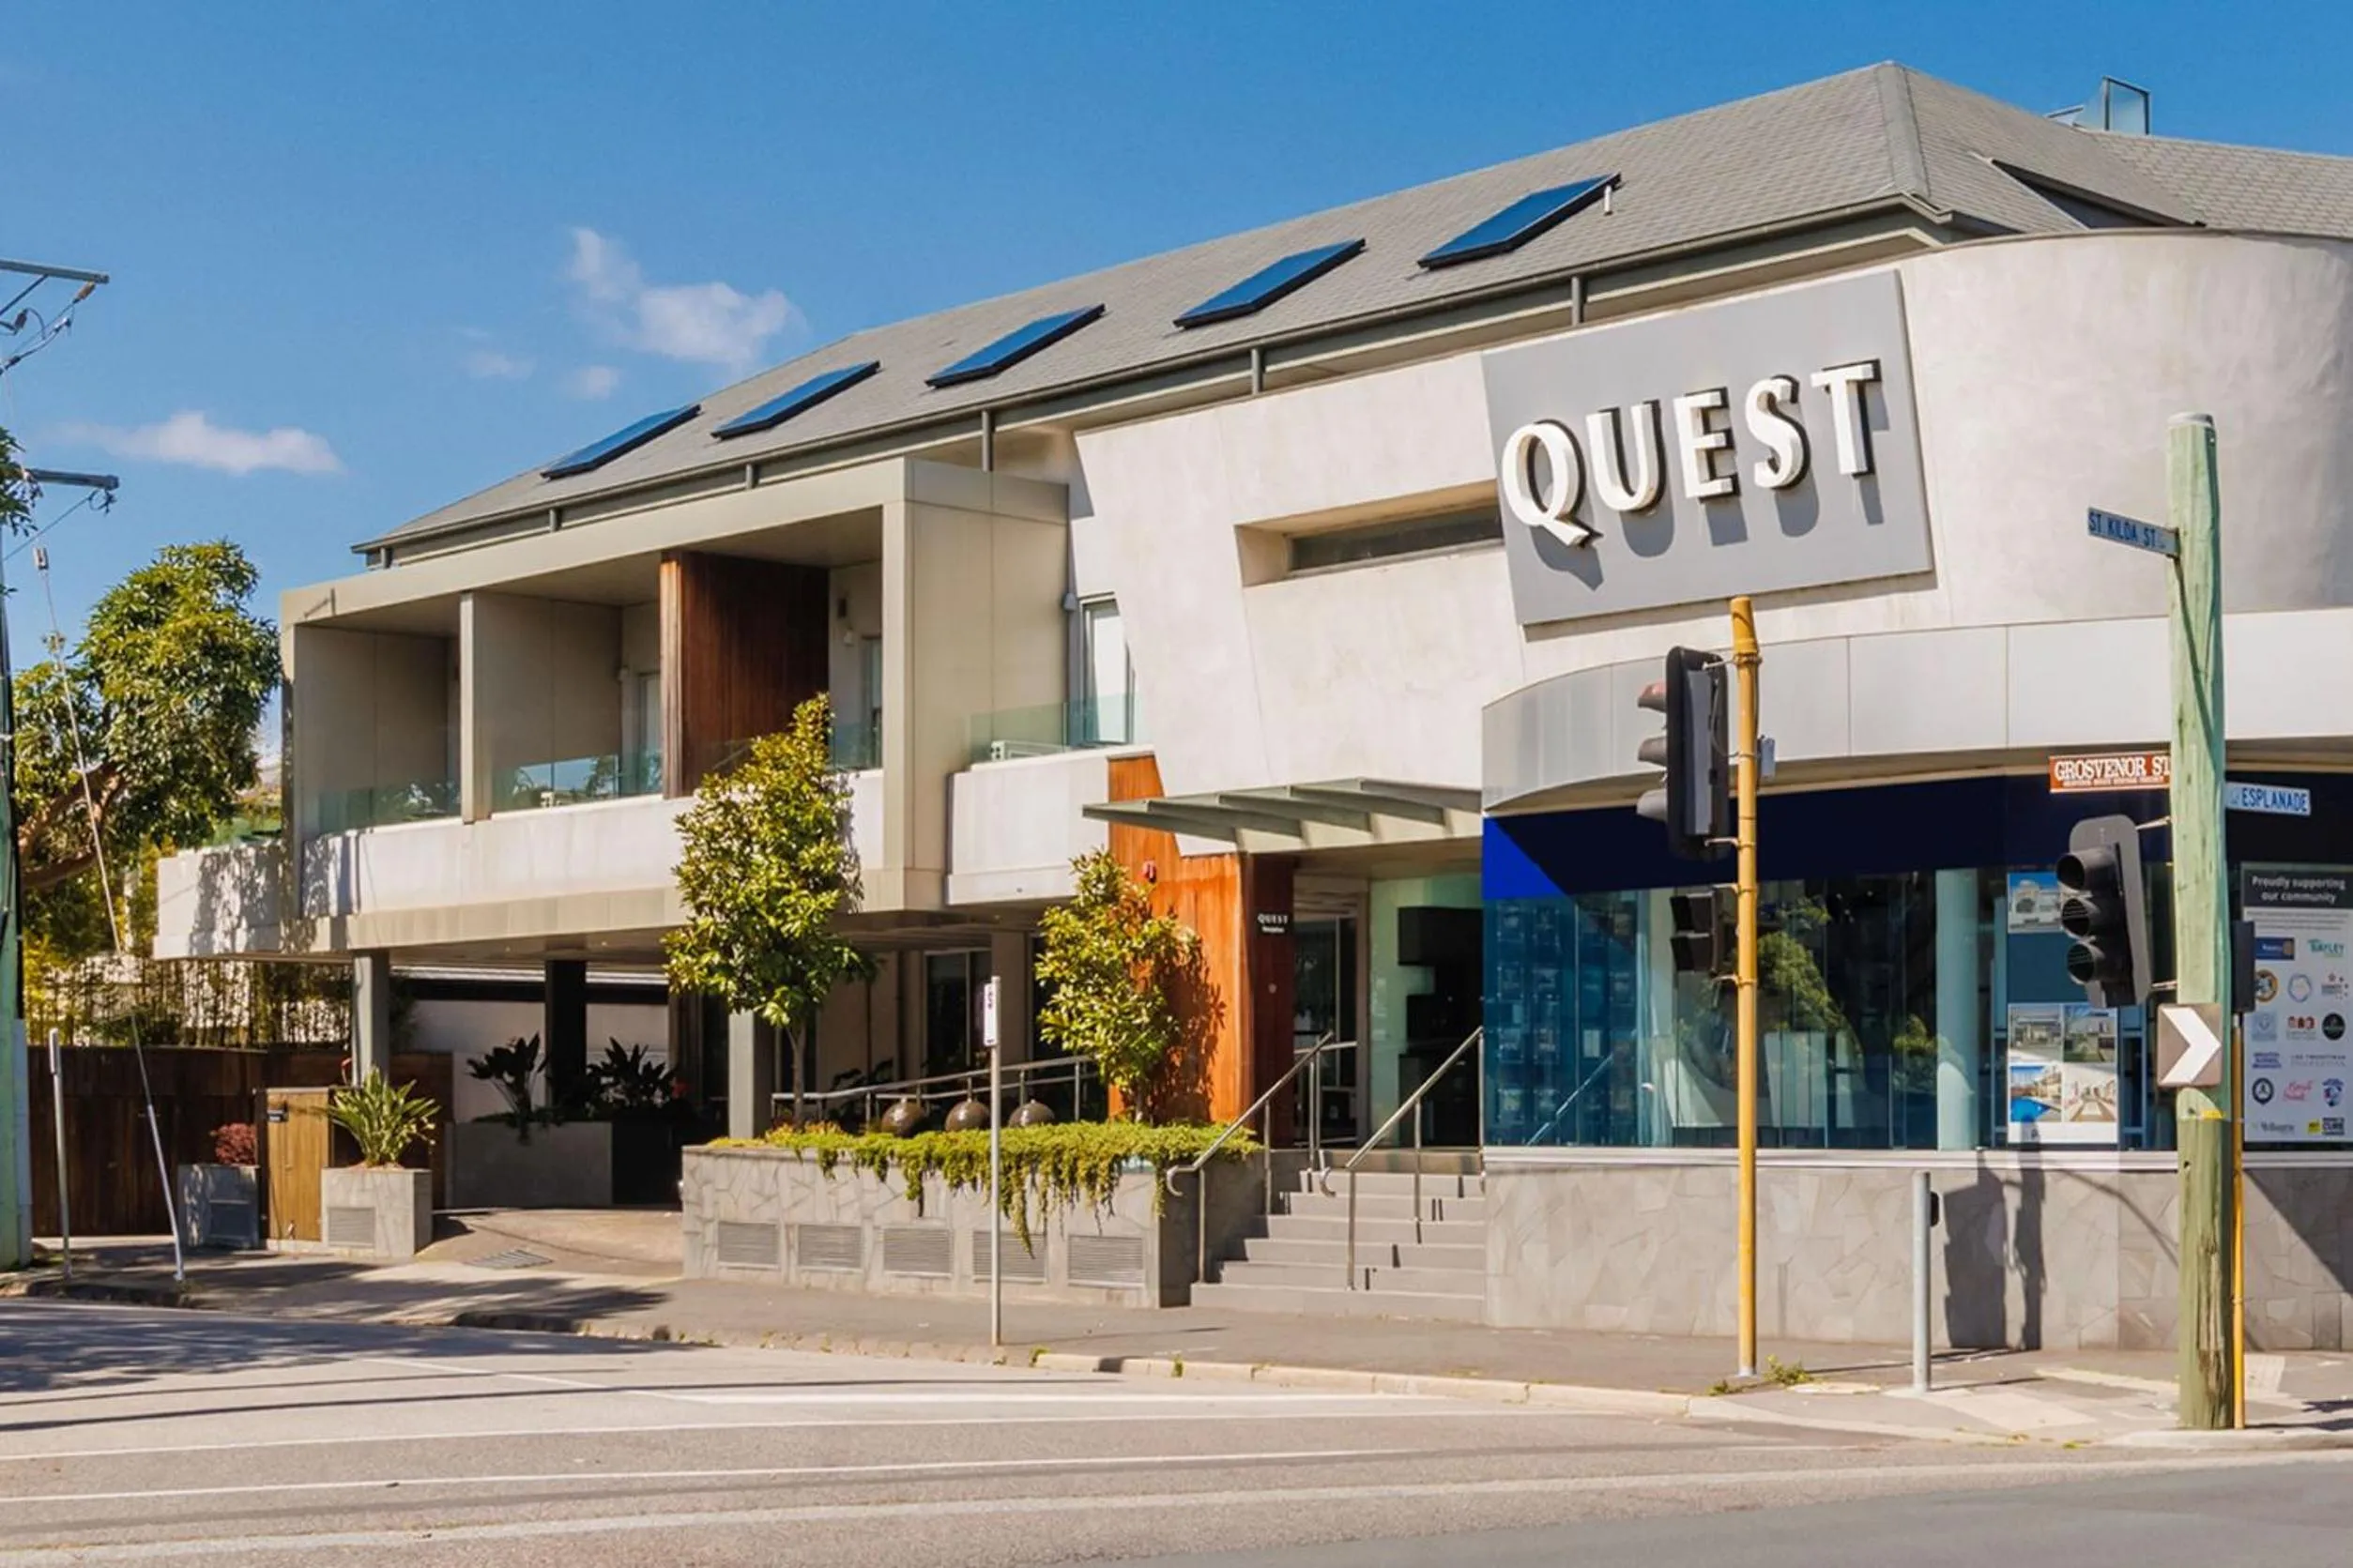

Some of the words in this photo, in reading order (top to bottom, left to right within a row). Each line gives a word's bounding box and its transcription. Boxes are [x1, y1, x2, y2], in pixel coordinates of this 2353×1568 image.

[1502, 358, 1881, 548] QUEST
[2088, 510, 2102, 534] ST
[2107, 517, 2138, 542] KILDA
[2143, 526, 2157, 548] ST
[2054, 756, 2147, 781] GROSVENOR
[2240, 787, 2308, 813] ESPLANADE
[2252, 875, 2290, 891] Proudly
[2292, 877, 2345, 891] supporting
[2261, 891, 2279, 901] our
[2281, 891, 2337, 905] community
